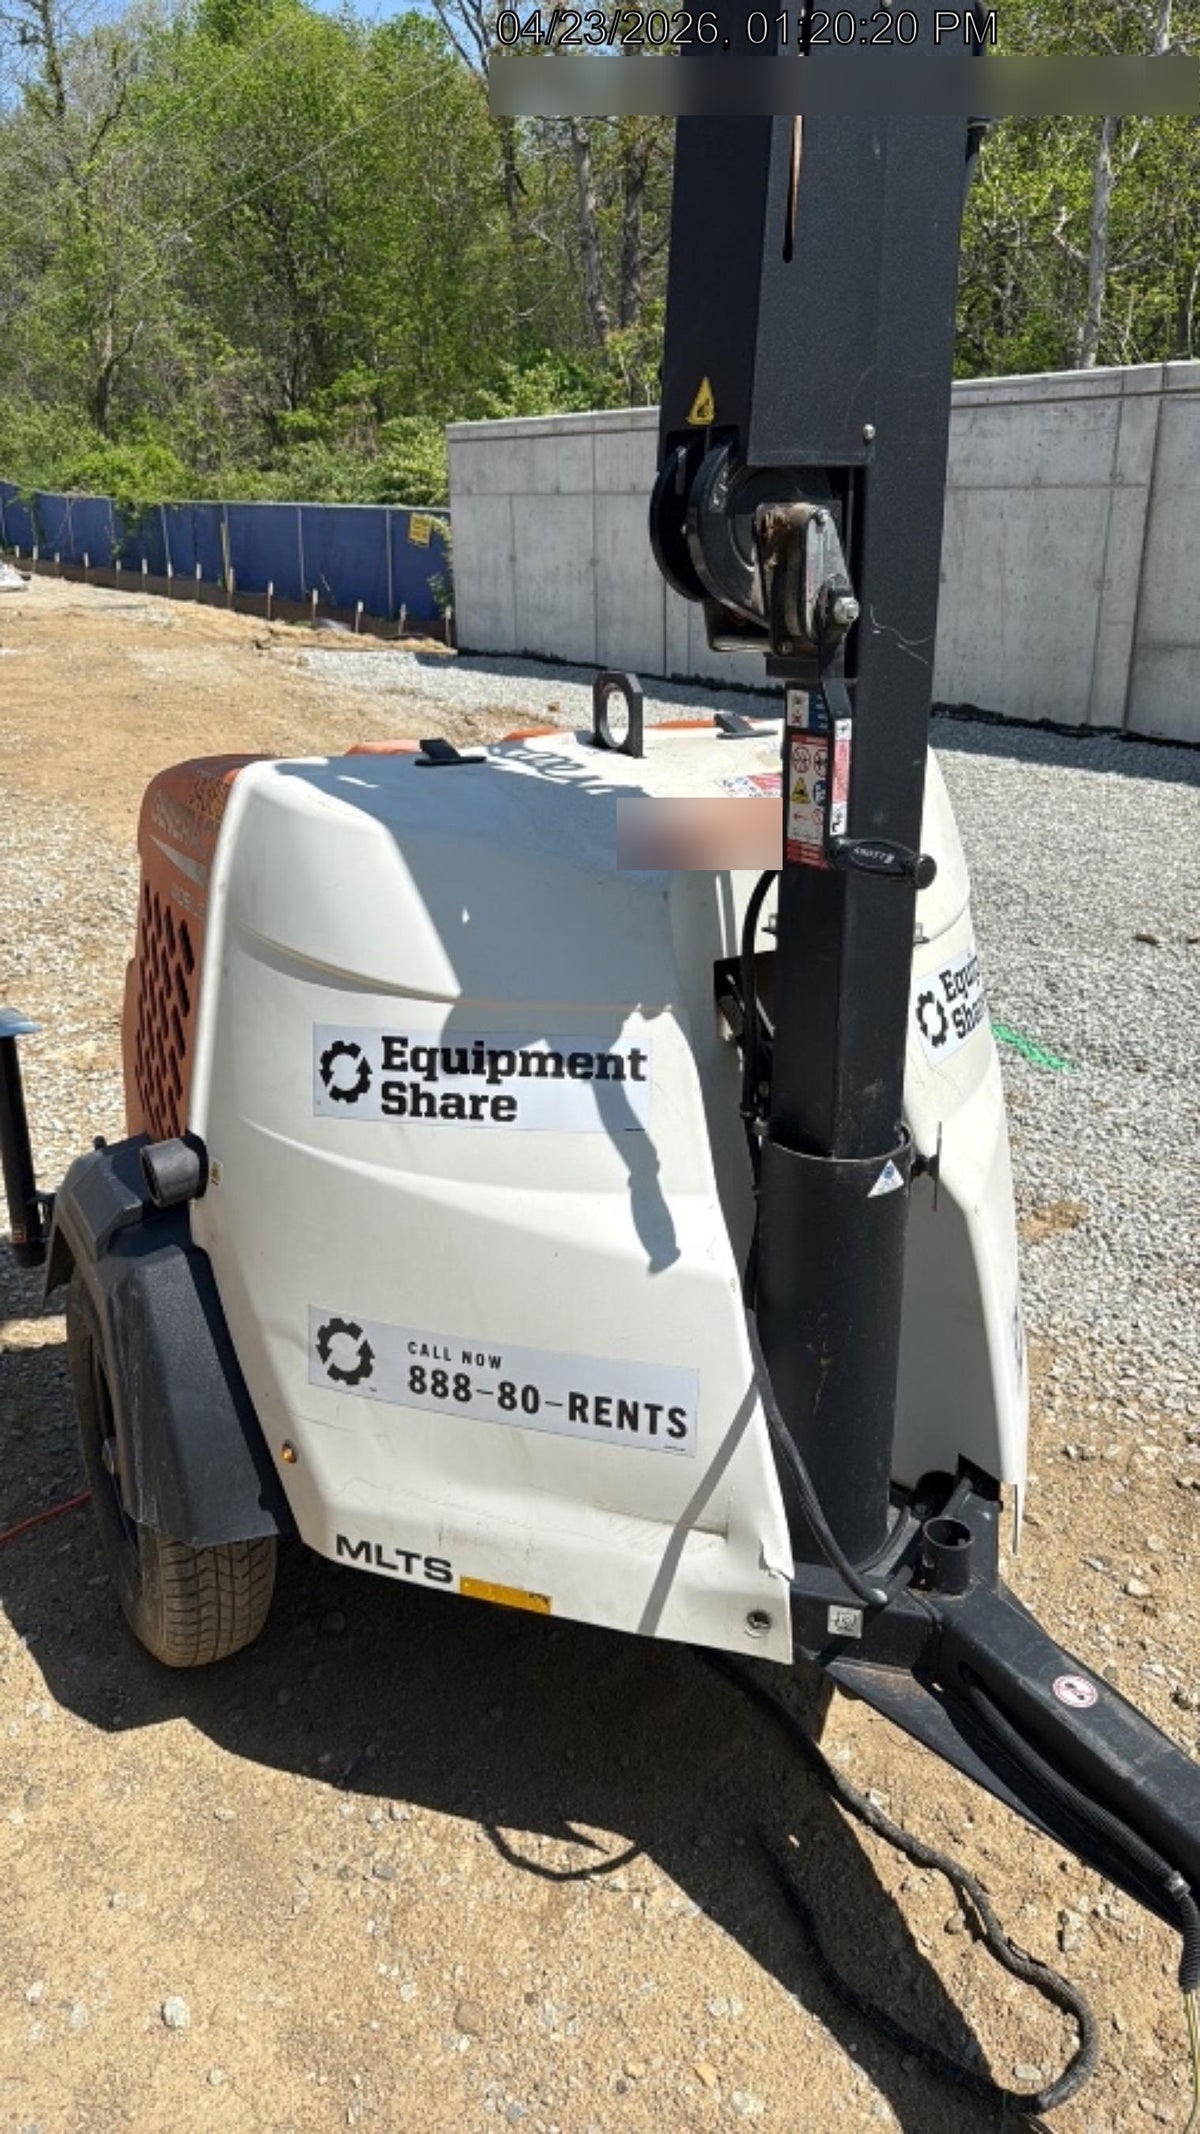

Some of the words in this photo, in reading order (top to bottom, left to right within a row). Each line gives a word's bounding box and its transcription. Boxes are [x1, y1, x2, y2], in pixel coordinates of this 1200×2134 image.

[381, 1036, 648, 1084] Equipment
[381, 1080, 518, 1122] Share
[407, 1341, 452, 1362] CALL
[462, 1350, 503, 1370] NOW
[408, 1364, 688, 1439] 888-80-RENTS
[336, 1534, 453, 1584] MLTS
